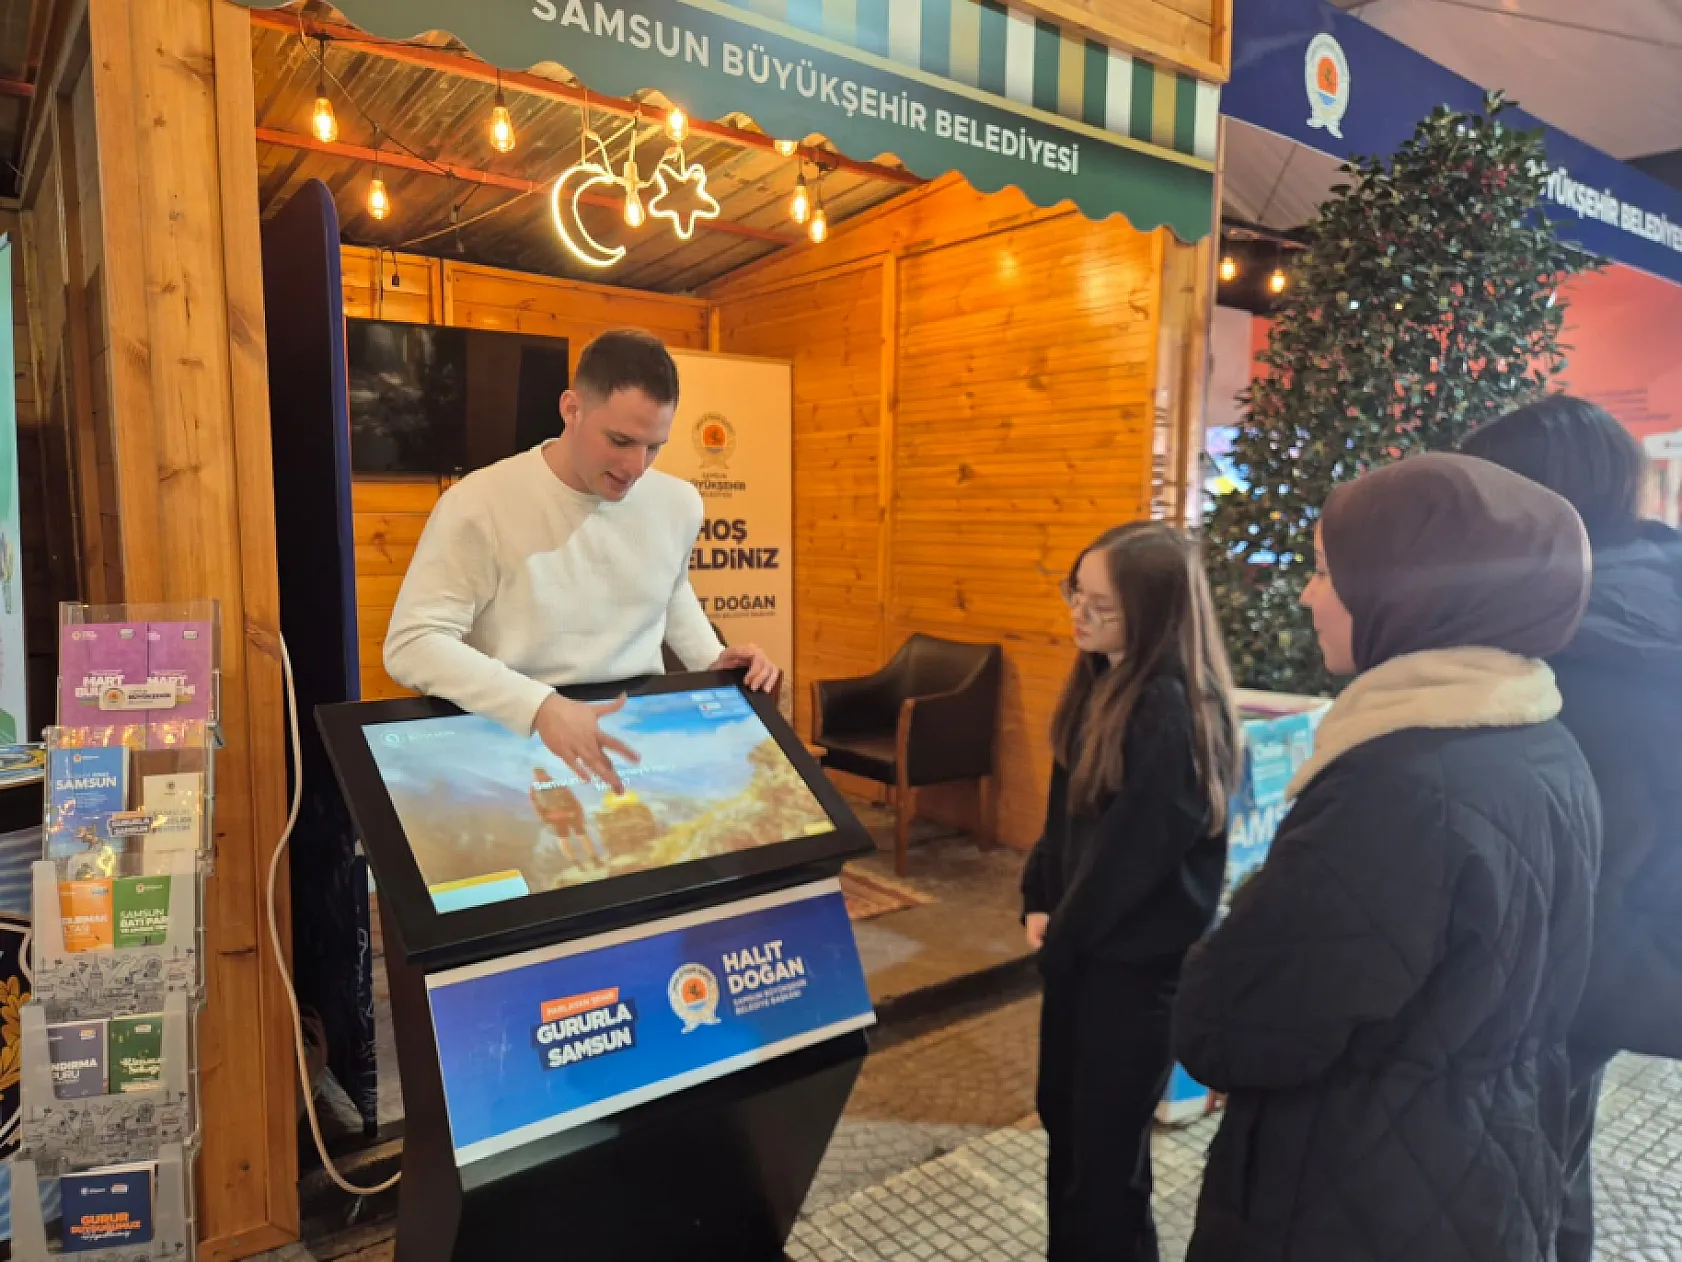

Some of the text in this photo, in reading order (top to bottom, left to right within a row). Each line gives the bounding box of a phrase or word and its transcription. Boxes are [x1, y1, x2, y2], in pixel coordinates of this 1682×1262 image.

[531, 0, 1079, 175] SAMSUN BÜYÜKŞEHİR BELEDİYESİ
[696, 518, 748, 545] HOŞ
[688, 546, 780, 570] ELDİNİZ
[714, 592, 776, 611] DOĞAN
[56, 775, 118, 791] SAMSUN
[728, 956, 805, 996] DOĞAN
[537, 1003, 633, 1044] GURURLA
[548, 1025, 632, 1068] SAMSUN
